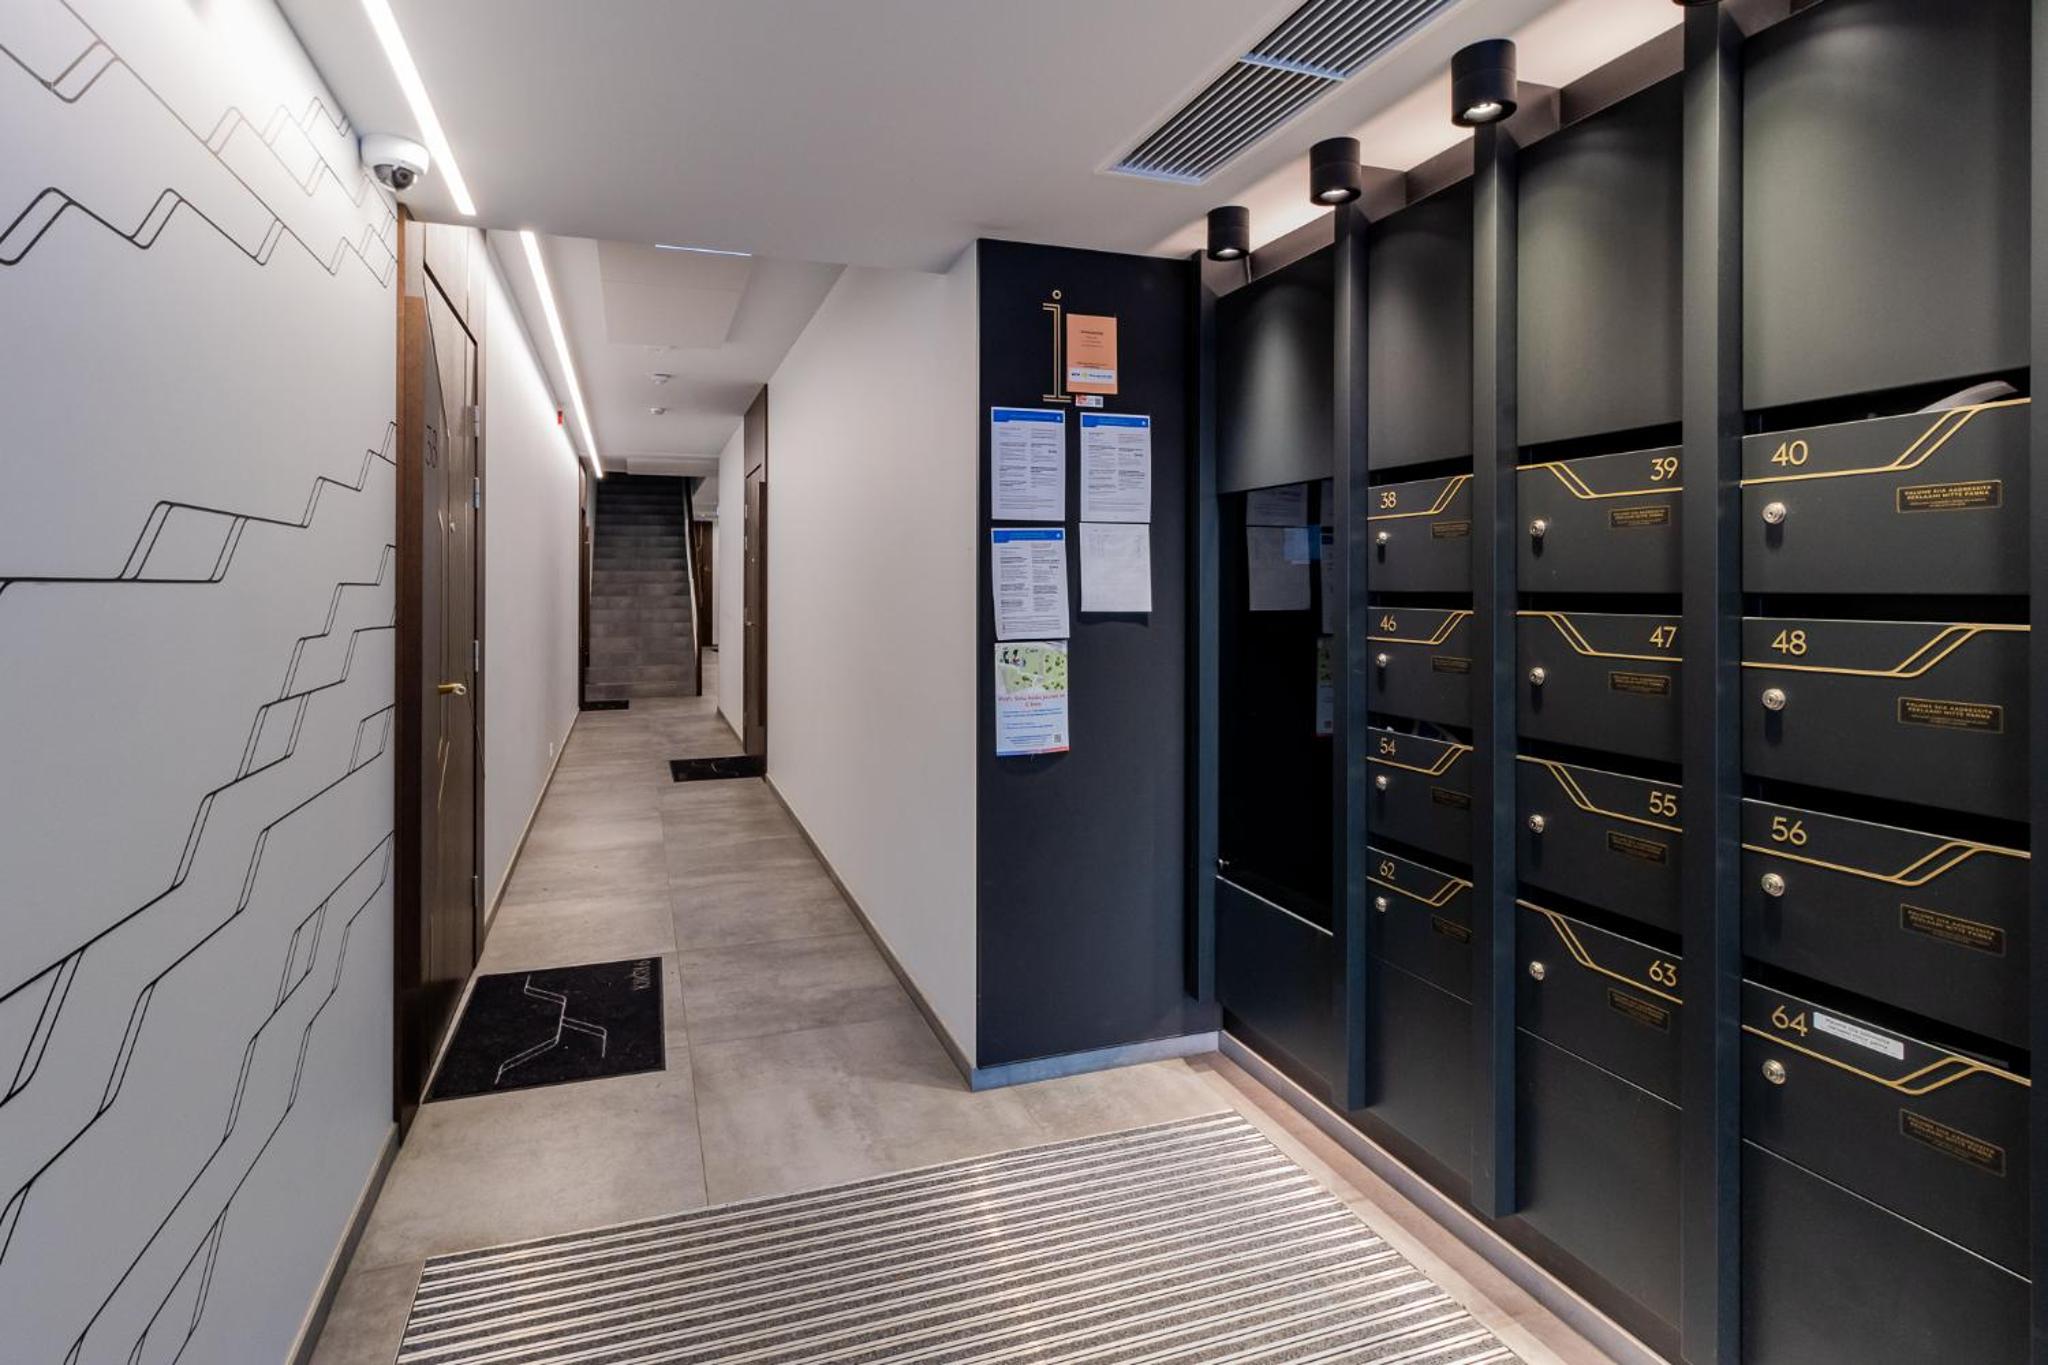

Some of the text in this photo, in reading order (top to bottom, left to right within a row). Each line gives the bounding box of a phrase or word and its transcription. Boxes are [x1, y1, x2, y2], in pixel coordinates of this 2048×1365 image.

[1771, 440, 1809, 466] 40
[1650, 456, 1678, 481] 39
[1379, 491, 1397, 509] 38
[1379, 615, 1397, 632] 46
[1649, 626, 1677, 648] 47
[1771, 630, 1807, 655] 48
[1379, 738, 1397, 756] 54
[1649, 791, 1677, 817] 55
[1771, 816, 1808, 846] 56
[1379, 860, 1396, 880] 62
[1649, 959, 1677, 988] 63
[1771, 1004, 1808, 1037] 64
